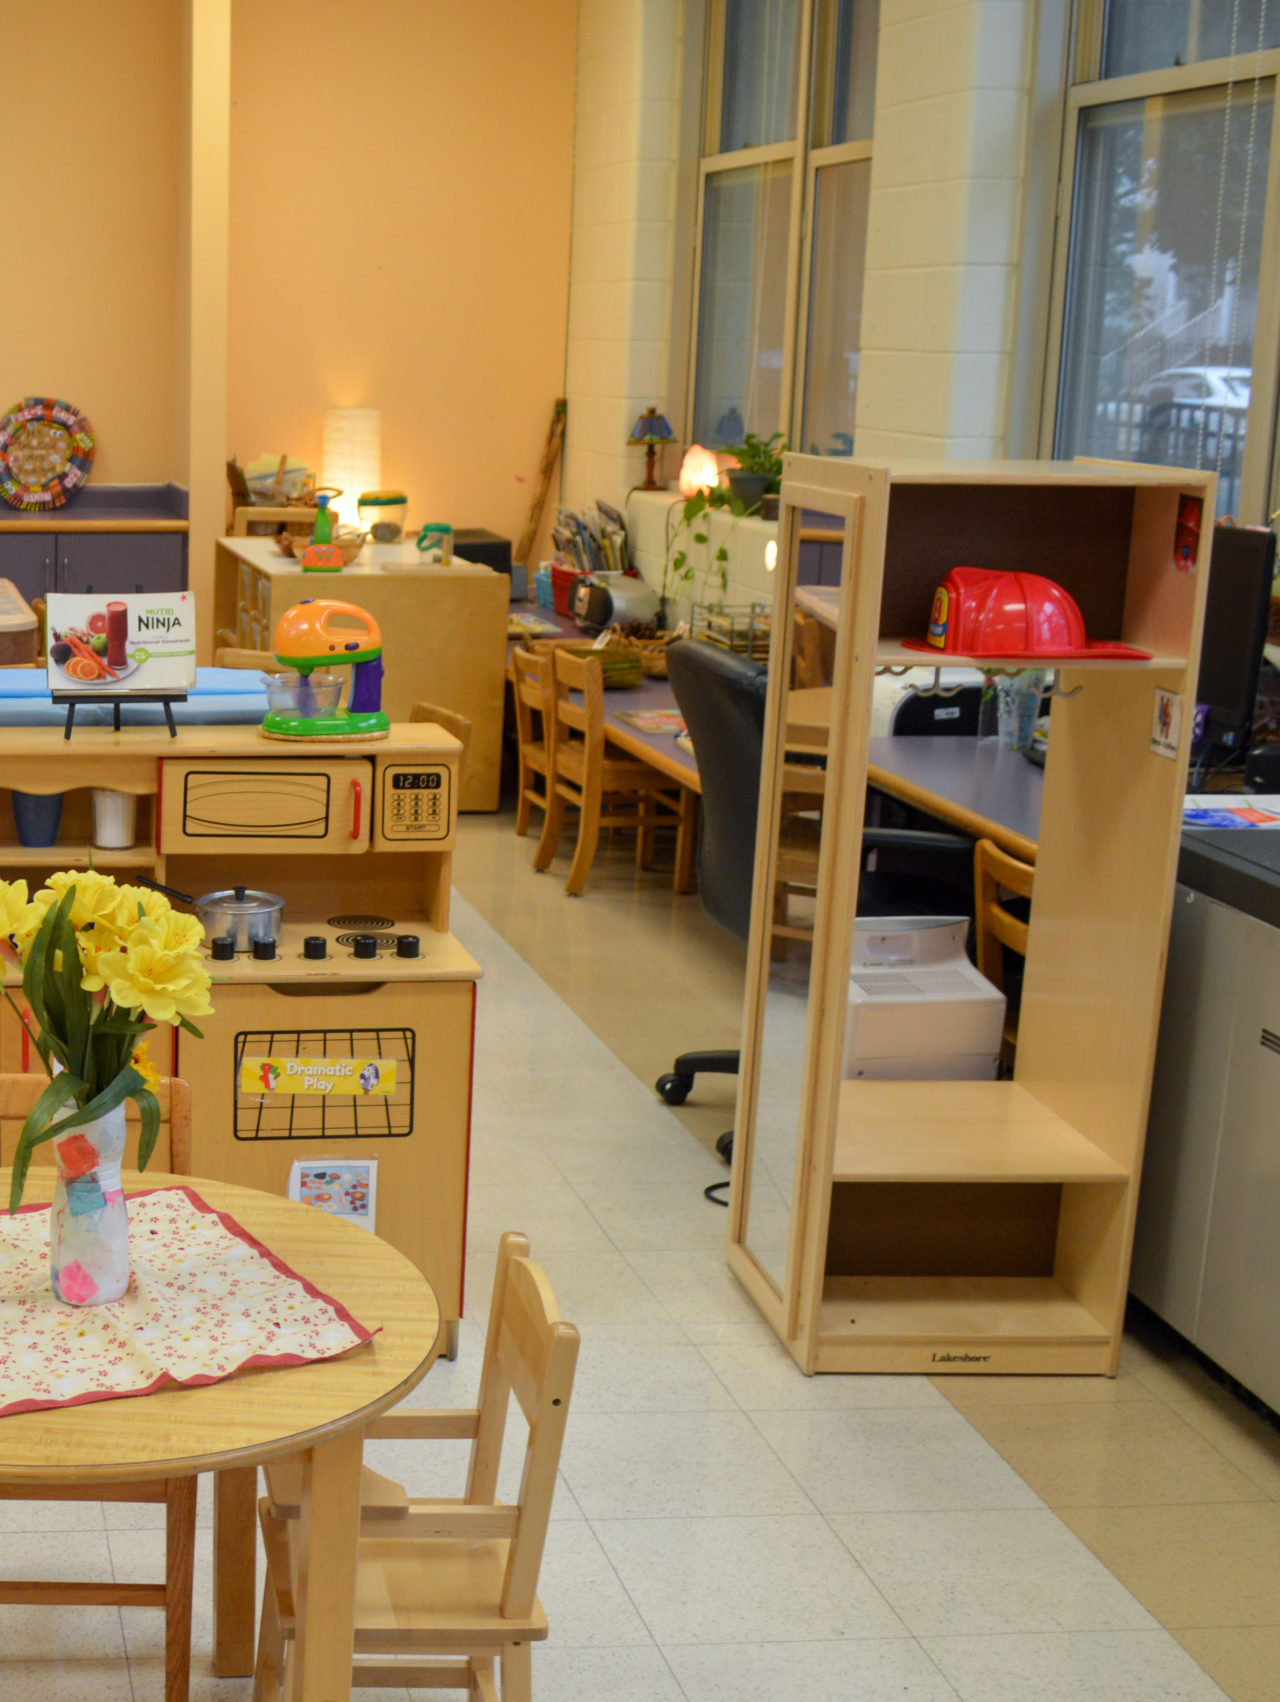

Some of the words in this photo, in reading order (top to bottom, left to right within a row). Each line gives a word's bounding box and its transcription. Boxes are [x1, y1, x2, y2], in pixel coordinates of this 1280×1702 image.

[145, 608, 175, 616] NUTRI
[138, 615, 182, 633] NINJA
[399, 775, 437, 788] 12:00
[286, 1062, 353, 1077] Dramatic
[304, 1076, 334, 1093] Play
[931, 1352, 990, 1362] Lakeshore
